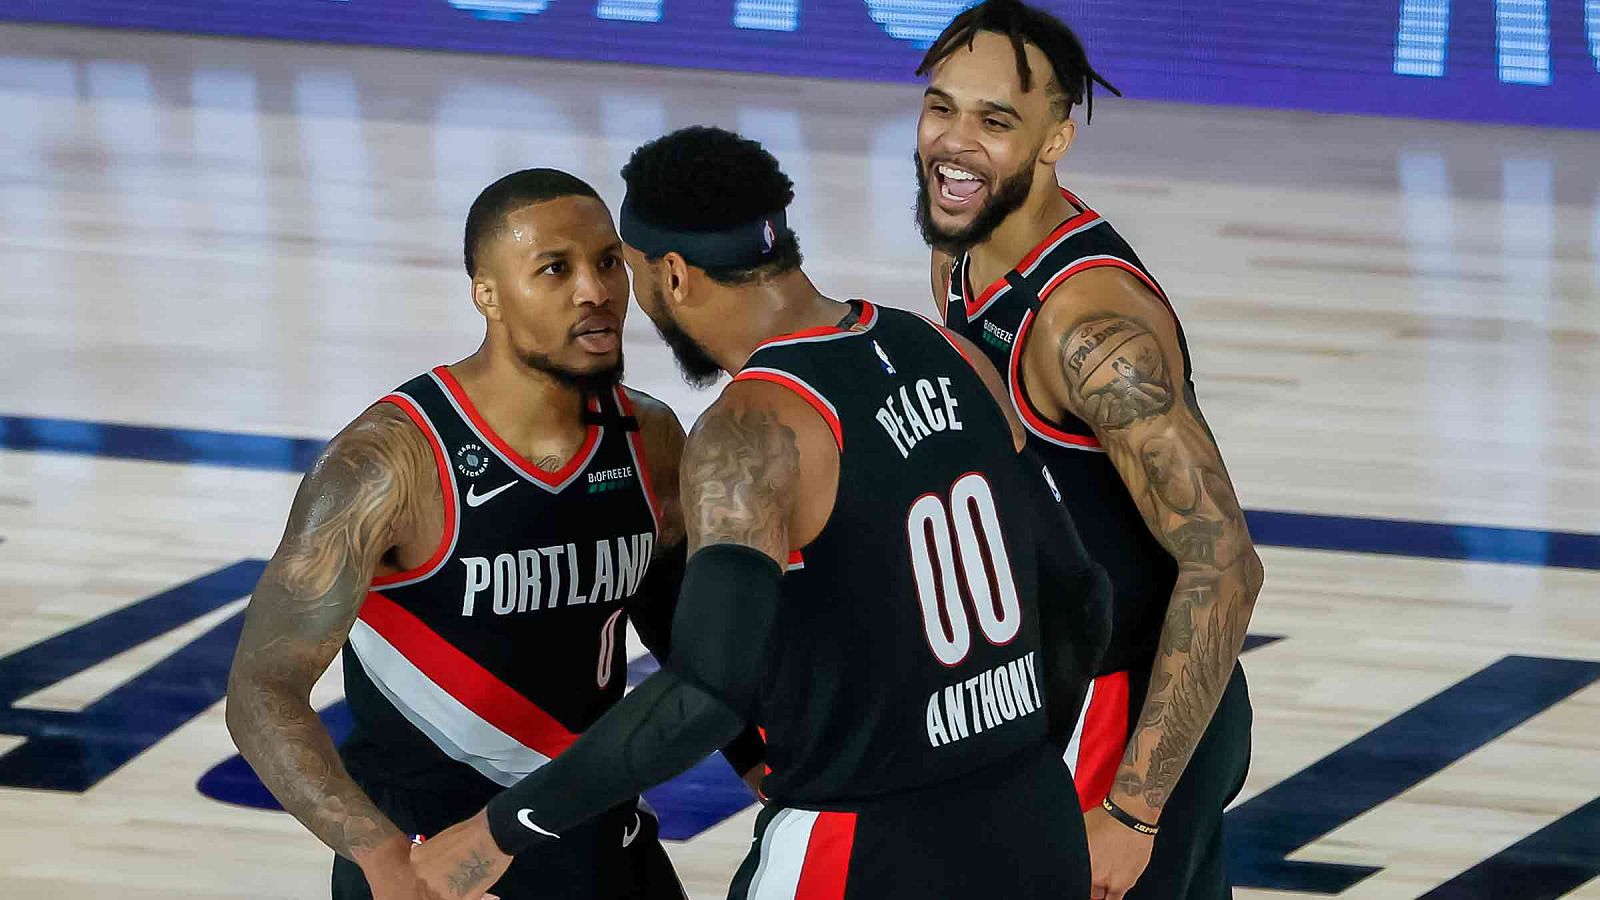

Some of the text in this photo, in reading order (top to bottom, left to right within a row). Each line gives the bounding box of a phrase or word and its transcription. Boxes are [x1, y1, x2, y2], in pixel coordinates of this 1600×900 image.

[457, 444, 482, 457] HARRY
[876, 377, 963, 458] PEACE
[458, 457, 489, 477] GLICKMAN
[459, 532, 653, 616] PORTLAND
[907, 472, 1021, 666] 00
[598, 608, 623, 688] 0
[927, 652, 1042, 748] ANTHONY
